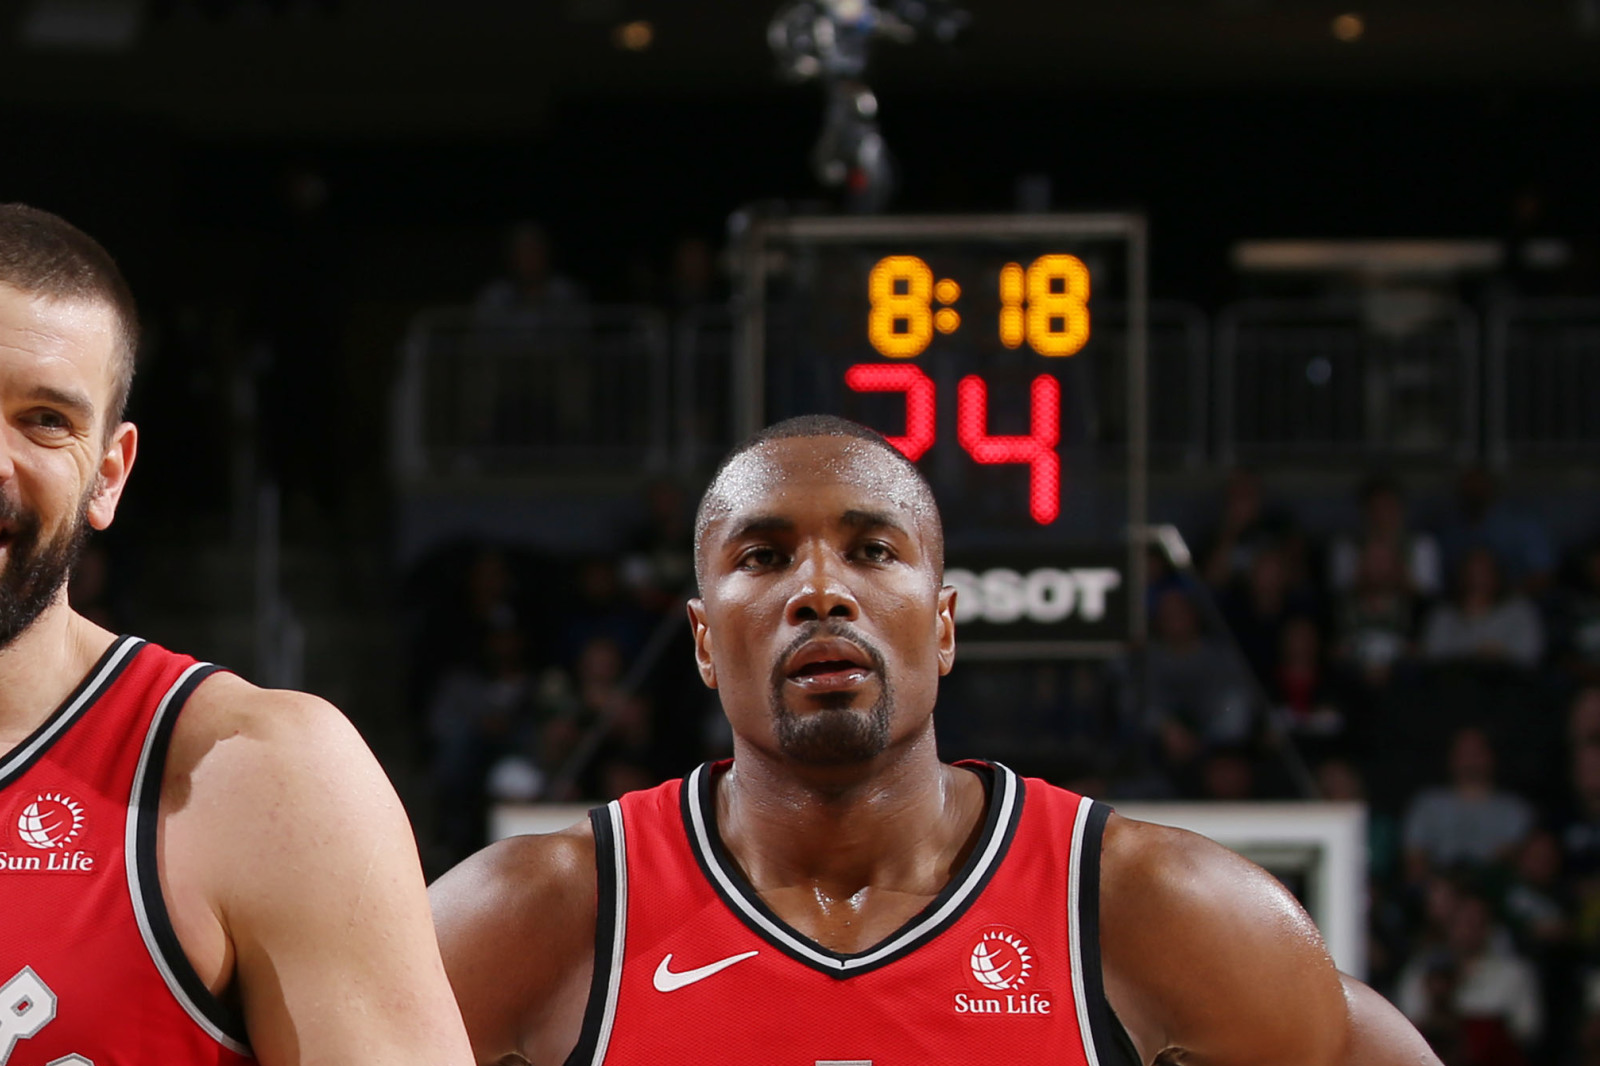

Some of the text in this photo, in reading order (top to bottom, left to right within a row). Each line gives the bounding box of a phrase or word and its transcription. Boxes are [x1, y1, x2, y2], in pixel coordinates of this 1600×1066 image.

[868, 255, 1091, 358] 8:18
[46, 850, 94, 871] Life
[954, 993, 1051, 1014] Sun Life
